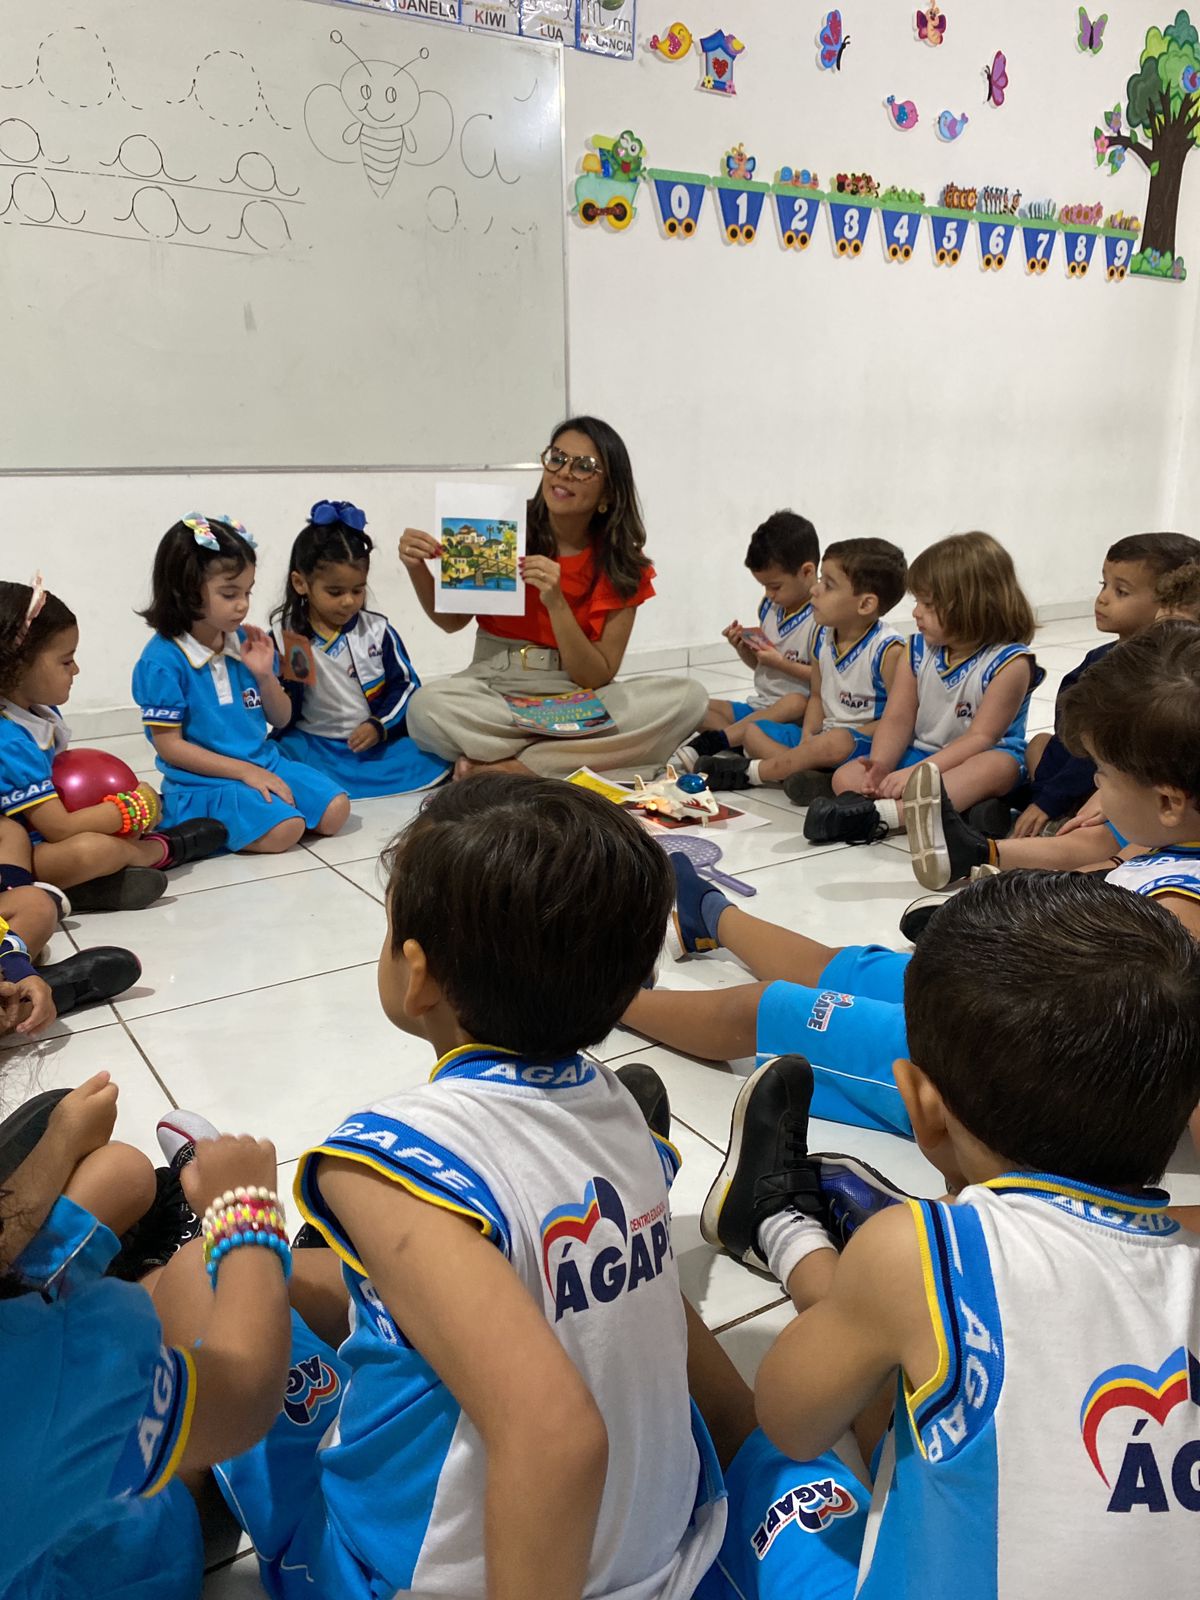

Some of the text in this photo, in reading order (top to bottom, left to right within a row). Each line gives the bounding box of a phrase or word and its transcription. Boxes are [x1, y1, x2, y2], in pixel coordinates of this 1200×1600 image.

[400, 0, 457, 19] JANELA
[474, 9, 506, 28] KIWI
[540, 24, 564, 41] LUA
[581, 33, 633, 53] MLANCIA
[670, 184, 1128, 267] 0 1 2 3 4 5 6 7 8 9
[141, 708, 180, 719] APE
[555, 1214, 673, 1324] ÁGAP
[753, 1480, 814, 1554] ÁGAPE
